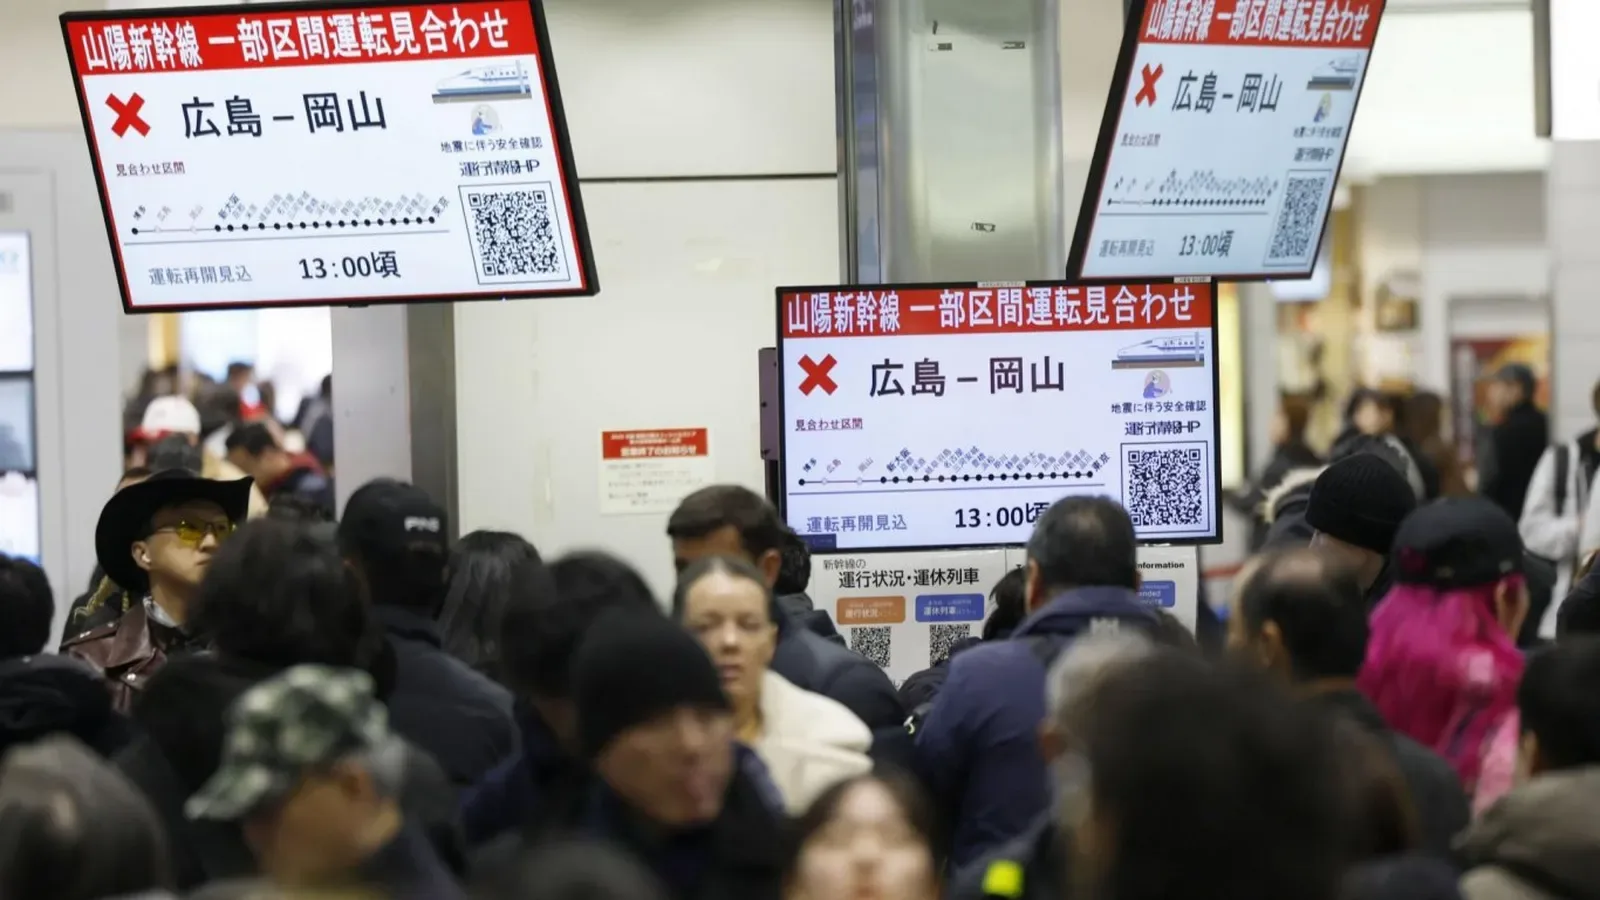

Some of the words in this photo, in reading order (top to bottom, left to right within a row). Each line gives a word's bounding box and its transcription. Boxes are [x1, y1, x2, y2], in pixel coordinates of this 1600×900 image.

[1146, 0, 1215, 42] 山陽新幹線
[1217, 0, 1370, 42] 一部区間運転見合わせ
[82, 22, 202, 71] 山陽新幹線
[208, 9, 508, 63] 一部区間運転見合わせ
[441, 137, 543, 152] 地震に伴う安全確認
[116, 161, 186, 177] 見合わせ区間
[1178, 230, 1234, 258] 13:00頃
[149, 265, 252, 286] 運転再開見込
[298, 251, 401, 280] 13:00頃
[788, 292, 900, 334] 山陽新幹線
[909, 286, 1195, 328] 一部区間運転見合わせ
[1111, 400, 1207, 414] 地震に伴う安全確認
[795, 417, 863, 432] 見合わせ区間
[886, 447, 911, 473] 新大阪
[1092, 452, 1110, 472] 東京
[806, 512, 908, 533] 運転再開見込
[824, 559, 866, 571] 新幹線の
[1137, 561, 1185, 570] nformation
[839, 567, 979, 589] 運行状況・運休列車
